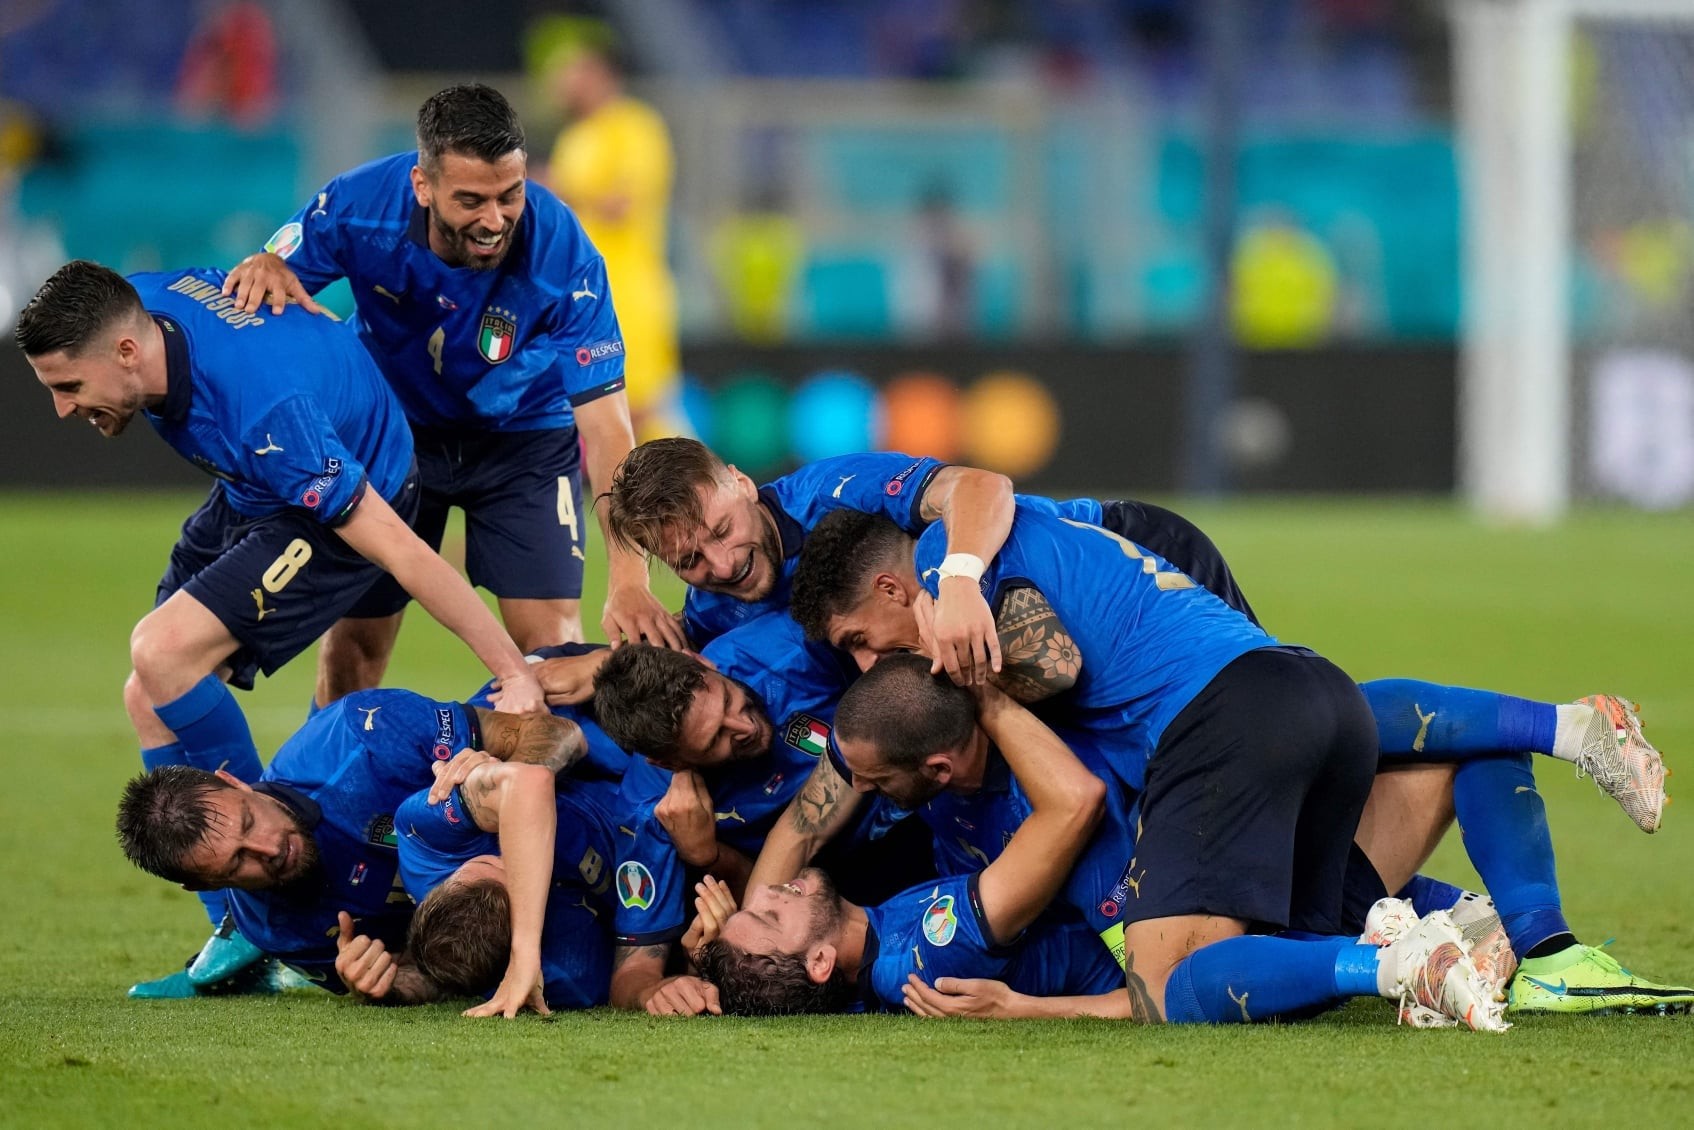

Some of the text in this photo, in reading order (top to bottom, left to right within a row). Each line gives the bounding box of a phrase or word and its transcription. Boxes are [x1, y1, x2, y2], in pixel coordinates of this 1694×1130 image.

[485, 317, 514, 333] ITALIA
[427, 326, 446, 375] 4
[590, 342, 623, 359] RESPECT
[314, 458, 340, 493] RESECT
[556, 476, 579, 541] 4
[262, 538, 312, 593] 8
[439, 709, 450, 745] RESPECT
[788, 716, 809, 743] ITALIA
